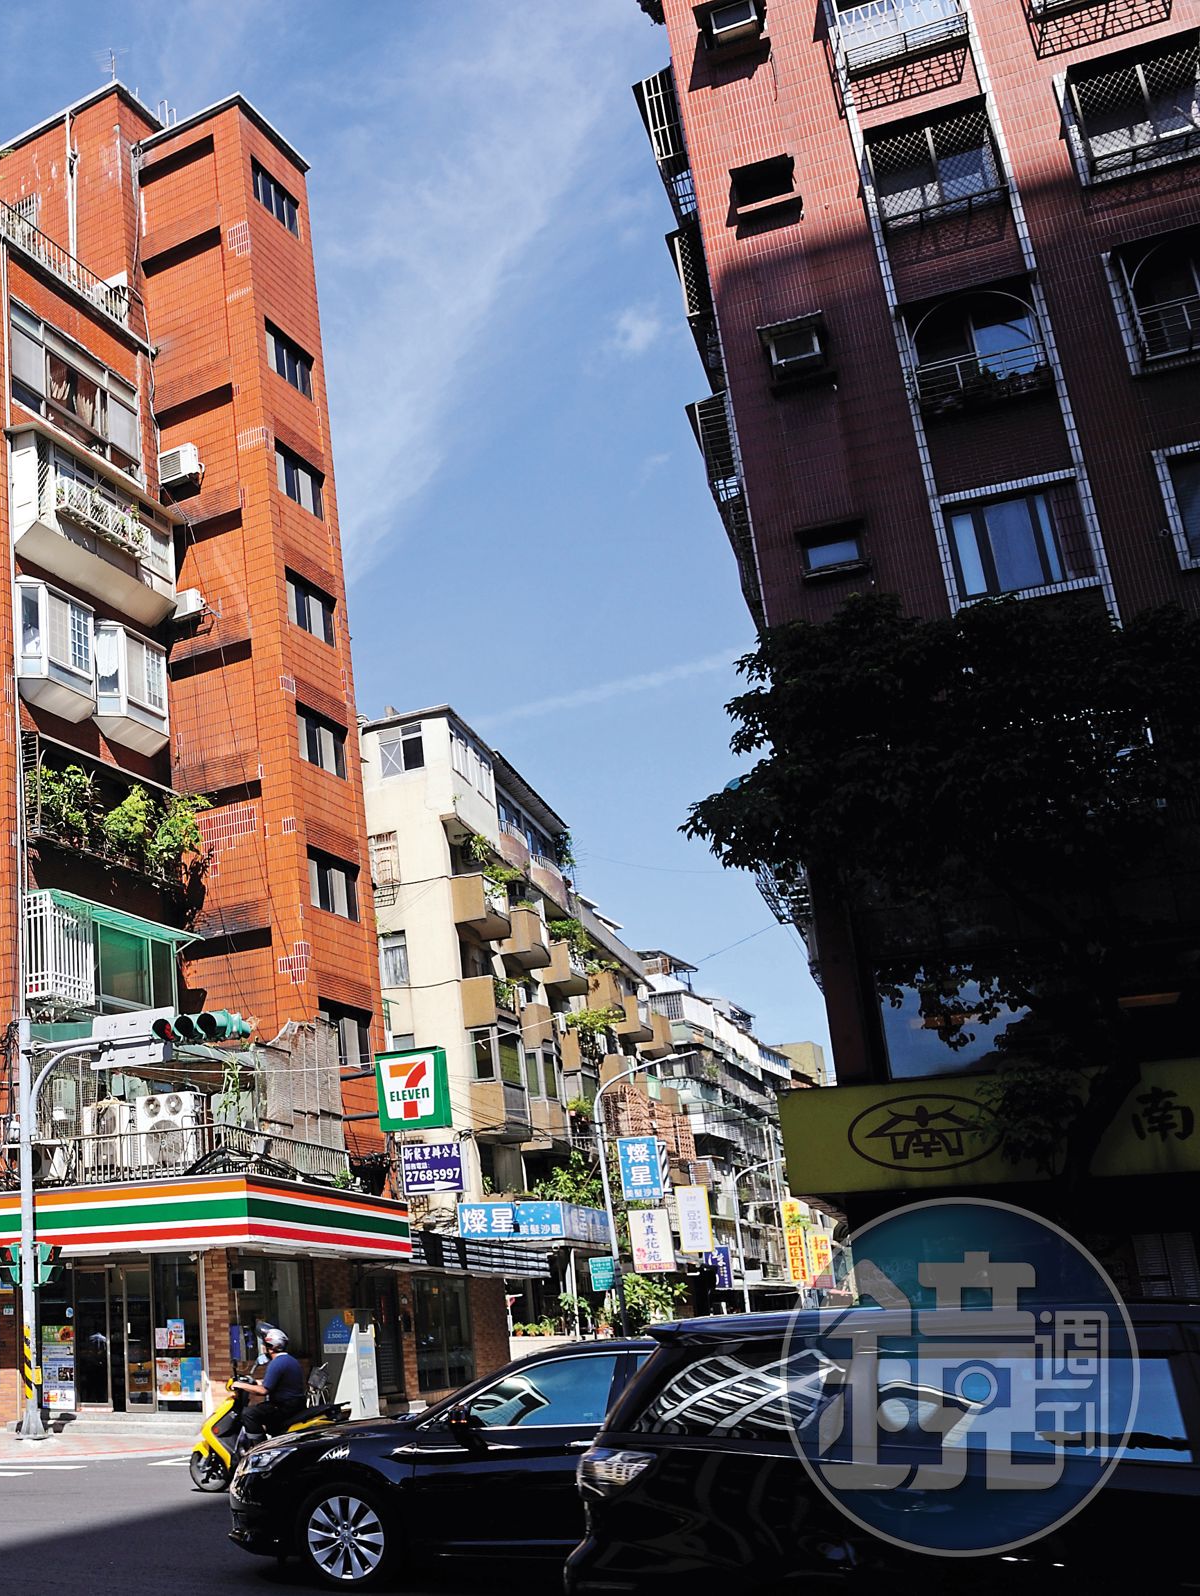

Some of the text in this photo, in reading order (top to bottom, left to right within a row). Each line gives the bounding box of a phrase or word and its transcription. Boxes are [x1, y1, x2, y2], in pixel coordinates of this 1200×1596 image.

[1132, 1086, 1194, 1142] 南
[405, 1167, 461, 1182] 27685997
[626, 1142, 654, 1187] 燦星
[461, 1208, 514, 1234] 燦星
